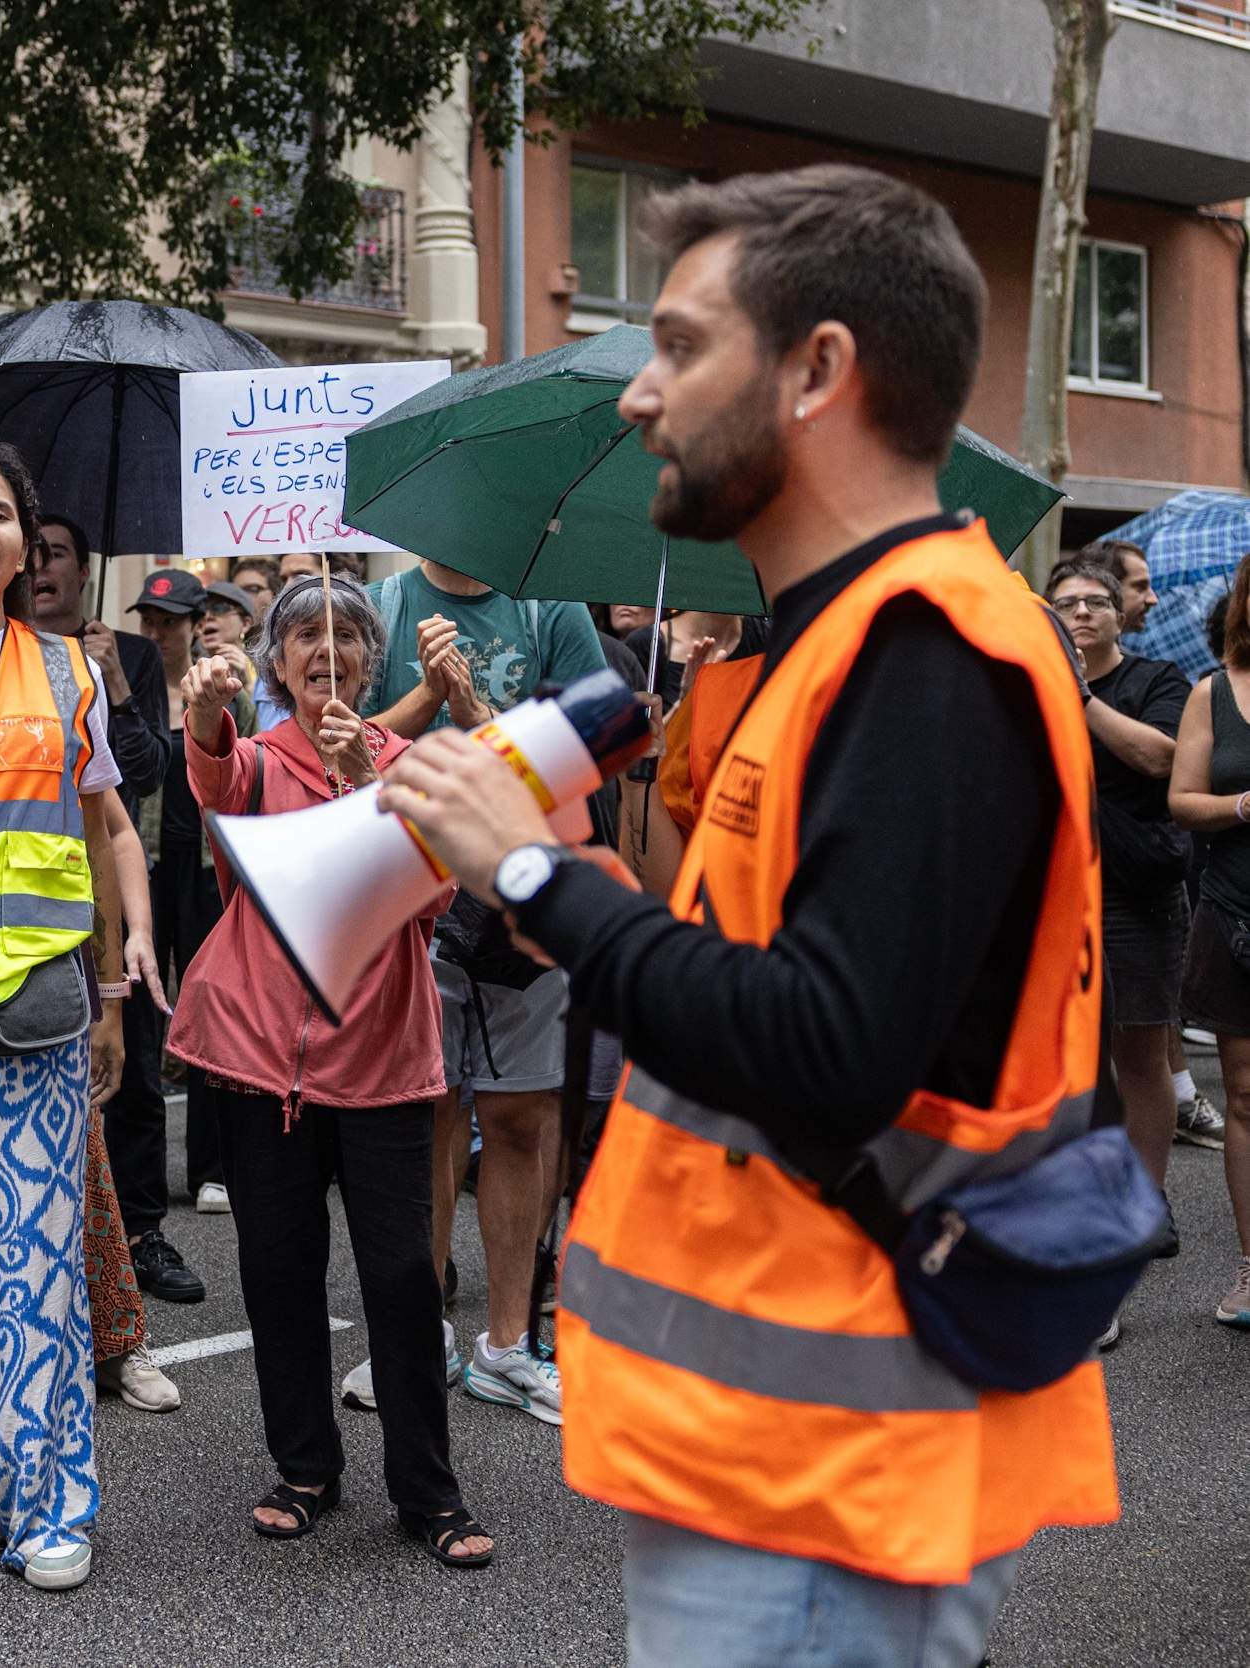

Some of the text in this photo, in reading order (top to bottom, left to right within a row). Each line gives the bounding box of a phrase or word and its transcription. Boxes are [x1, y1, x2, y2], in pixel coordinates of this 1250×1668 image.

[231, 372, 375, 427] junts
[194, 442, 347, 473] PER L'ESPE
[221, 475, 266, 495] ELS
[224, 502, 372, 545] VERGO
